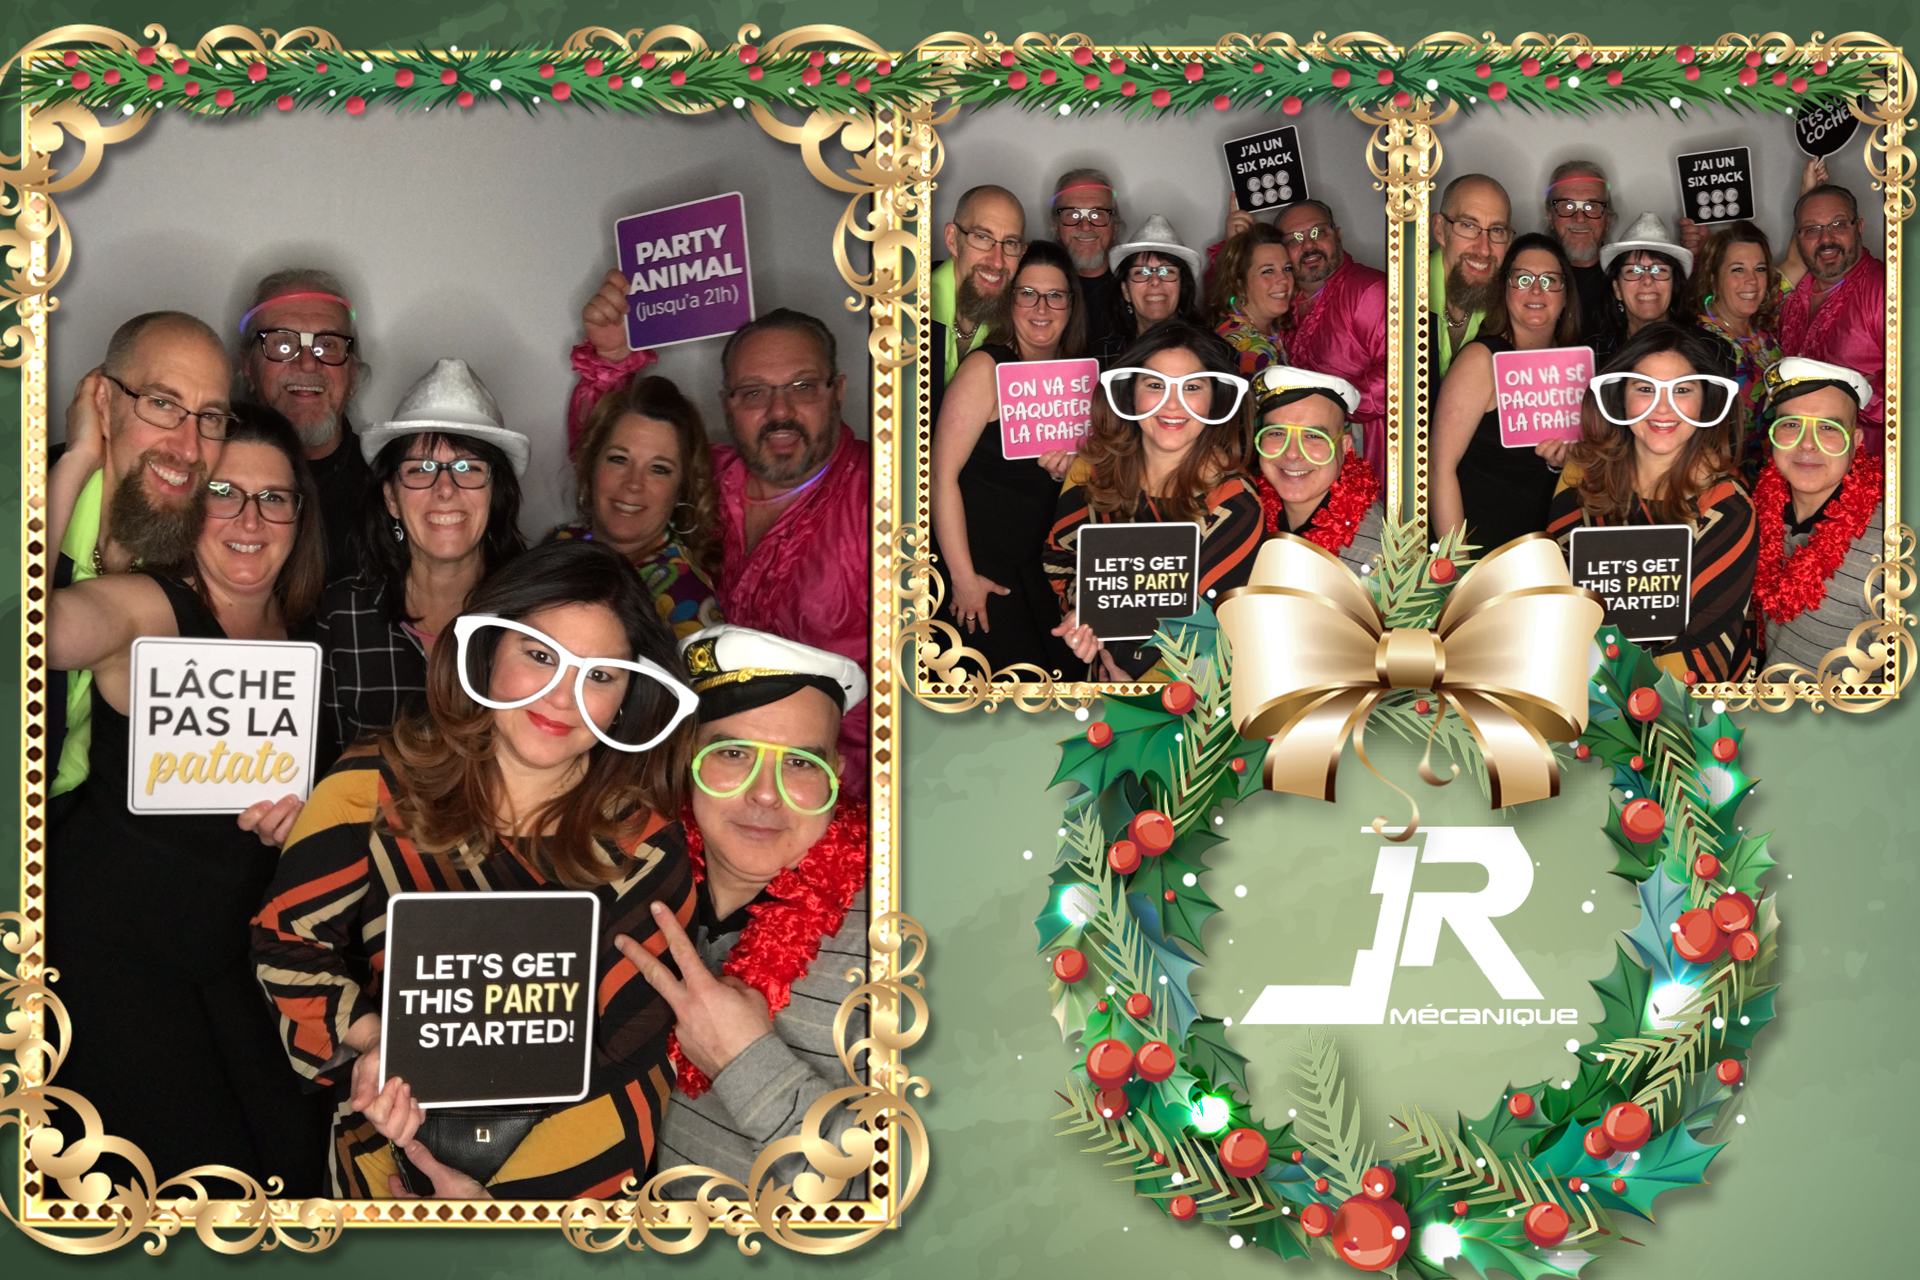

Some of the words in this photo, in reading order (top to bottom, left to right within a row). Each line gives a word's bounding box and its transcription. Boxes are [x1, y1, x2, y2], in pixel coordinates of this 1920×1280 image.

[1798, 108, 1824, 135] T'ES
[1240, 142, 1262, 158] J'AI
[1262, 137, 1283, 151] UN
[1236, 160, 1258, 175] SIX
[1259, 151, 1294, 169] PACK
[1692, 159, 1713, 172] J'AI
[1716, 156, 1735, 168] UN
[1687, 175, 1708, 188] SIX
[1710, 171, 1744, 185] PACK
[635, 224, 727, 265] PARTY
[629, 253, 743, 295] ANIMAL
[636, 293, 700, 322] (jusqu'a
[704, 284, 739, 305] 21h)
[1505, 367, 1533, 386] ON
[1538, 365, 1560, 384] VA
[1565, 363, 1586, 383] SE
[1008, 378, 1037, 398] ON
[1042, 376, 1065, 396] VA
[1070, 375, 1091, 393] SE
[1002, 398, 1092, 422] PAQUETER
[1508, 412, 1528, 432] LA
[1532, 409, 1581, 431] FRAIS
[1010, 424, 1031, 444] LA
[1094, 557, 1145, 573] LET'S
[1149, 556, 1187, 571] GET
[1587, 560, 1637, 575] LET'S
[1642, 558, 1680, 573] GET
[1085, 576, 1128, 591] THIS
[1134, 572, 1189, 591] PARTY
[1578, 579, 1621, 593] THIS
[1627, 575, 1682, 593] PARTY
[1097, 593, 1187, 609] STARTED!
[1604, 595, 1680, 611] TARTED!
[150, 658, 296, 700] LÂCHE
[149, 705, 230, 737] PAS
[247, 707, 298, 737] LA
[145, 740, 299, 796] patate
[416, 953, 503, 980] LET'S
[512, 952, 577, 978] GET
[399, 988, 474, 1014] THIS
[484, 982, 580, 1014] PARTY
[418, 1019, 575, 1048] STARTED!
